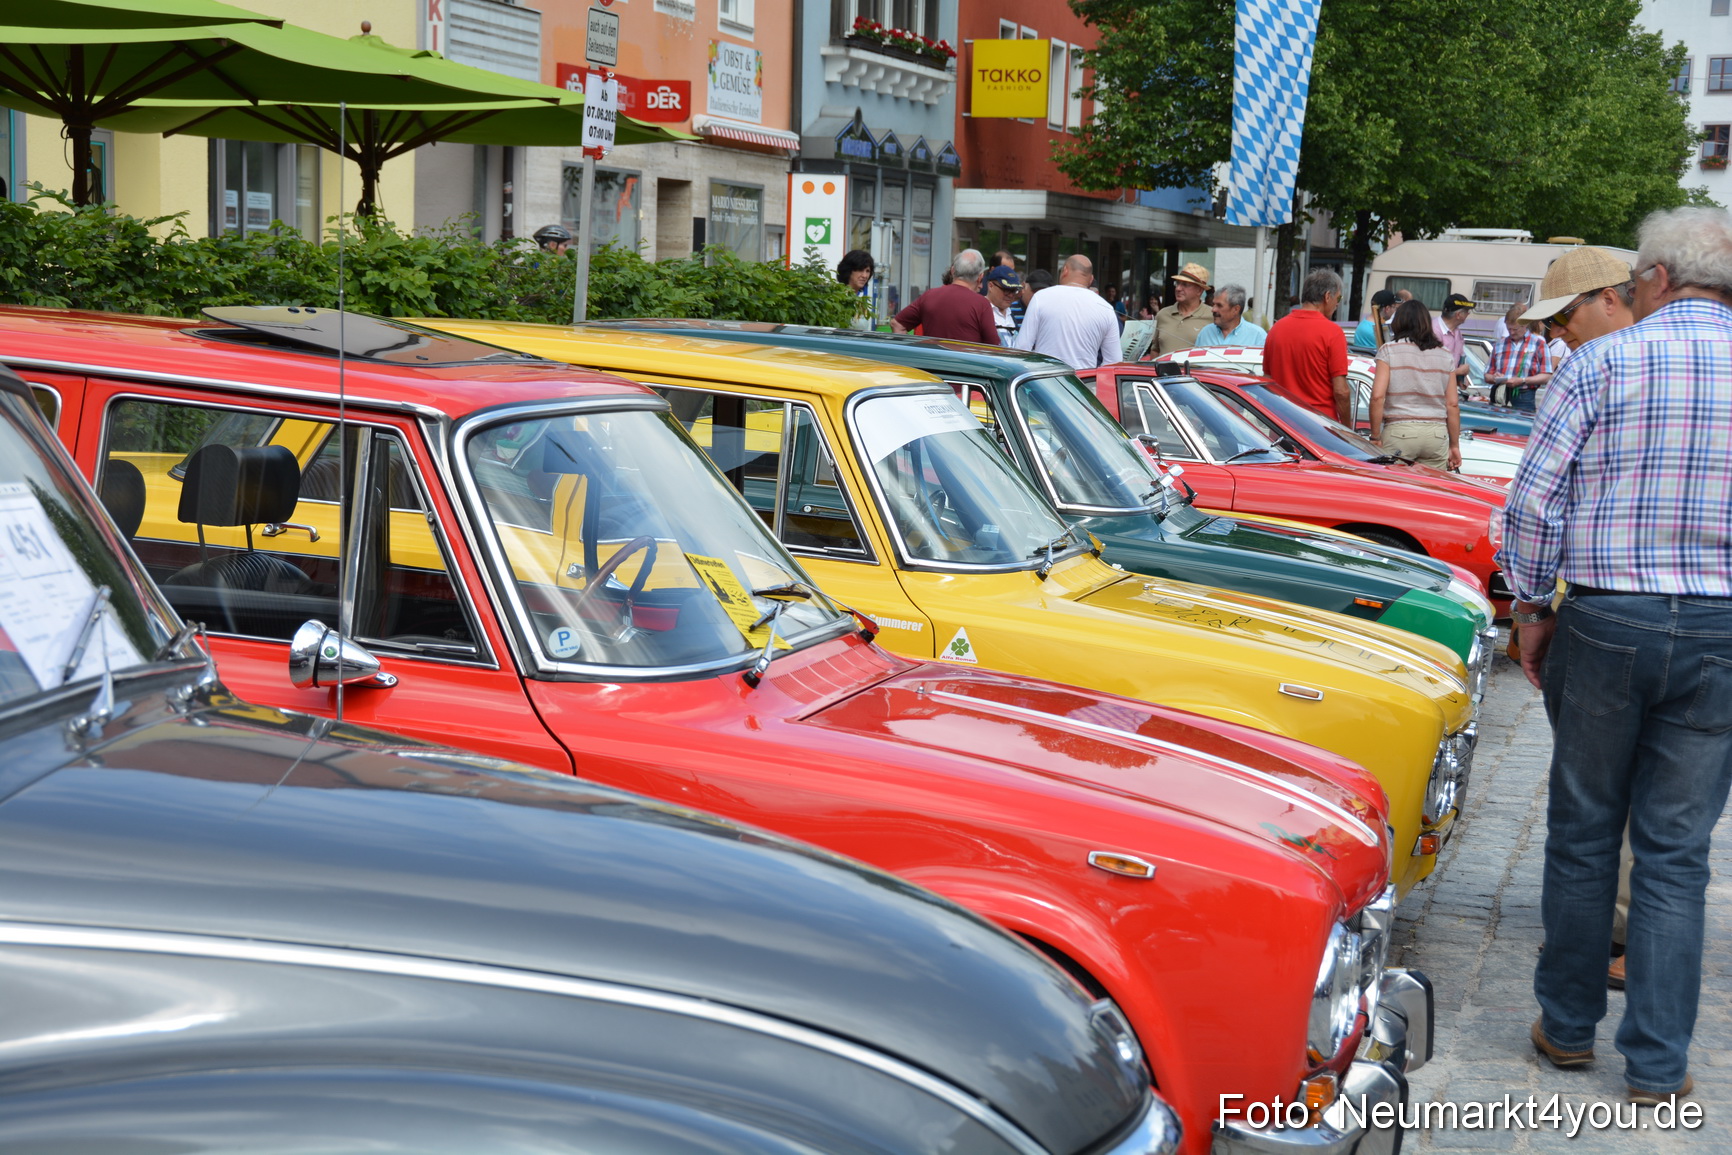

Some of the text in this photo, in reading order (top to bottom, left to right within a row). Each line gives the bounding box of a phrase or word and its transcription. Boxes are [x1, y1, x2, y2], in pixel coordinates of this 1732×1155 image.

[590, 19, 600, 34] auch
[608, 22, 617, 38] dem
[588, 37, 616, 58] Seitenstreifen
[724, 49, 752, 72] OBST &
[720, 72, 752, 96] GEMÜSE
[601, 89, 609, 102] Ab
[647, 90, 681, 110] DER
[709, 96, 760, 119] Italienische Feinkost
[588, 125, 613, 142] 07:00 Uhr
[711, 194, 730, 209] MARIO
[6, 521, 53, 561] 451
[557, 631, 571, 647] P
